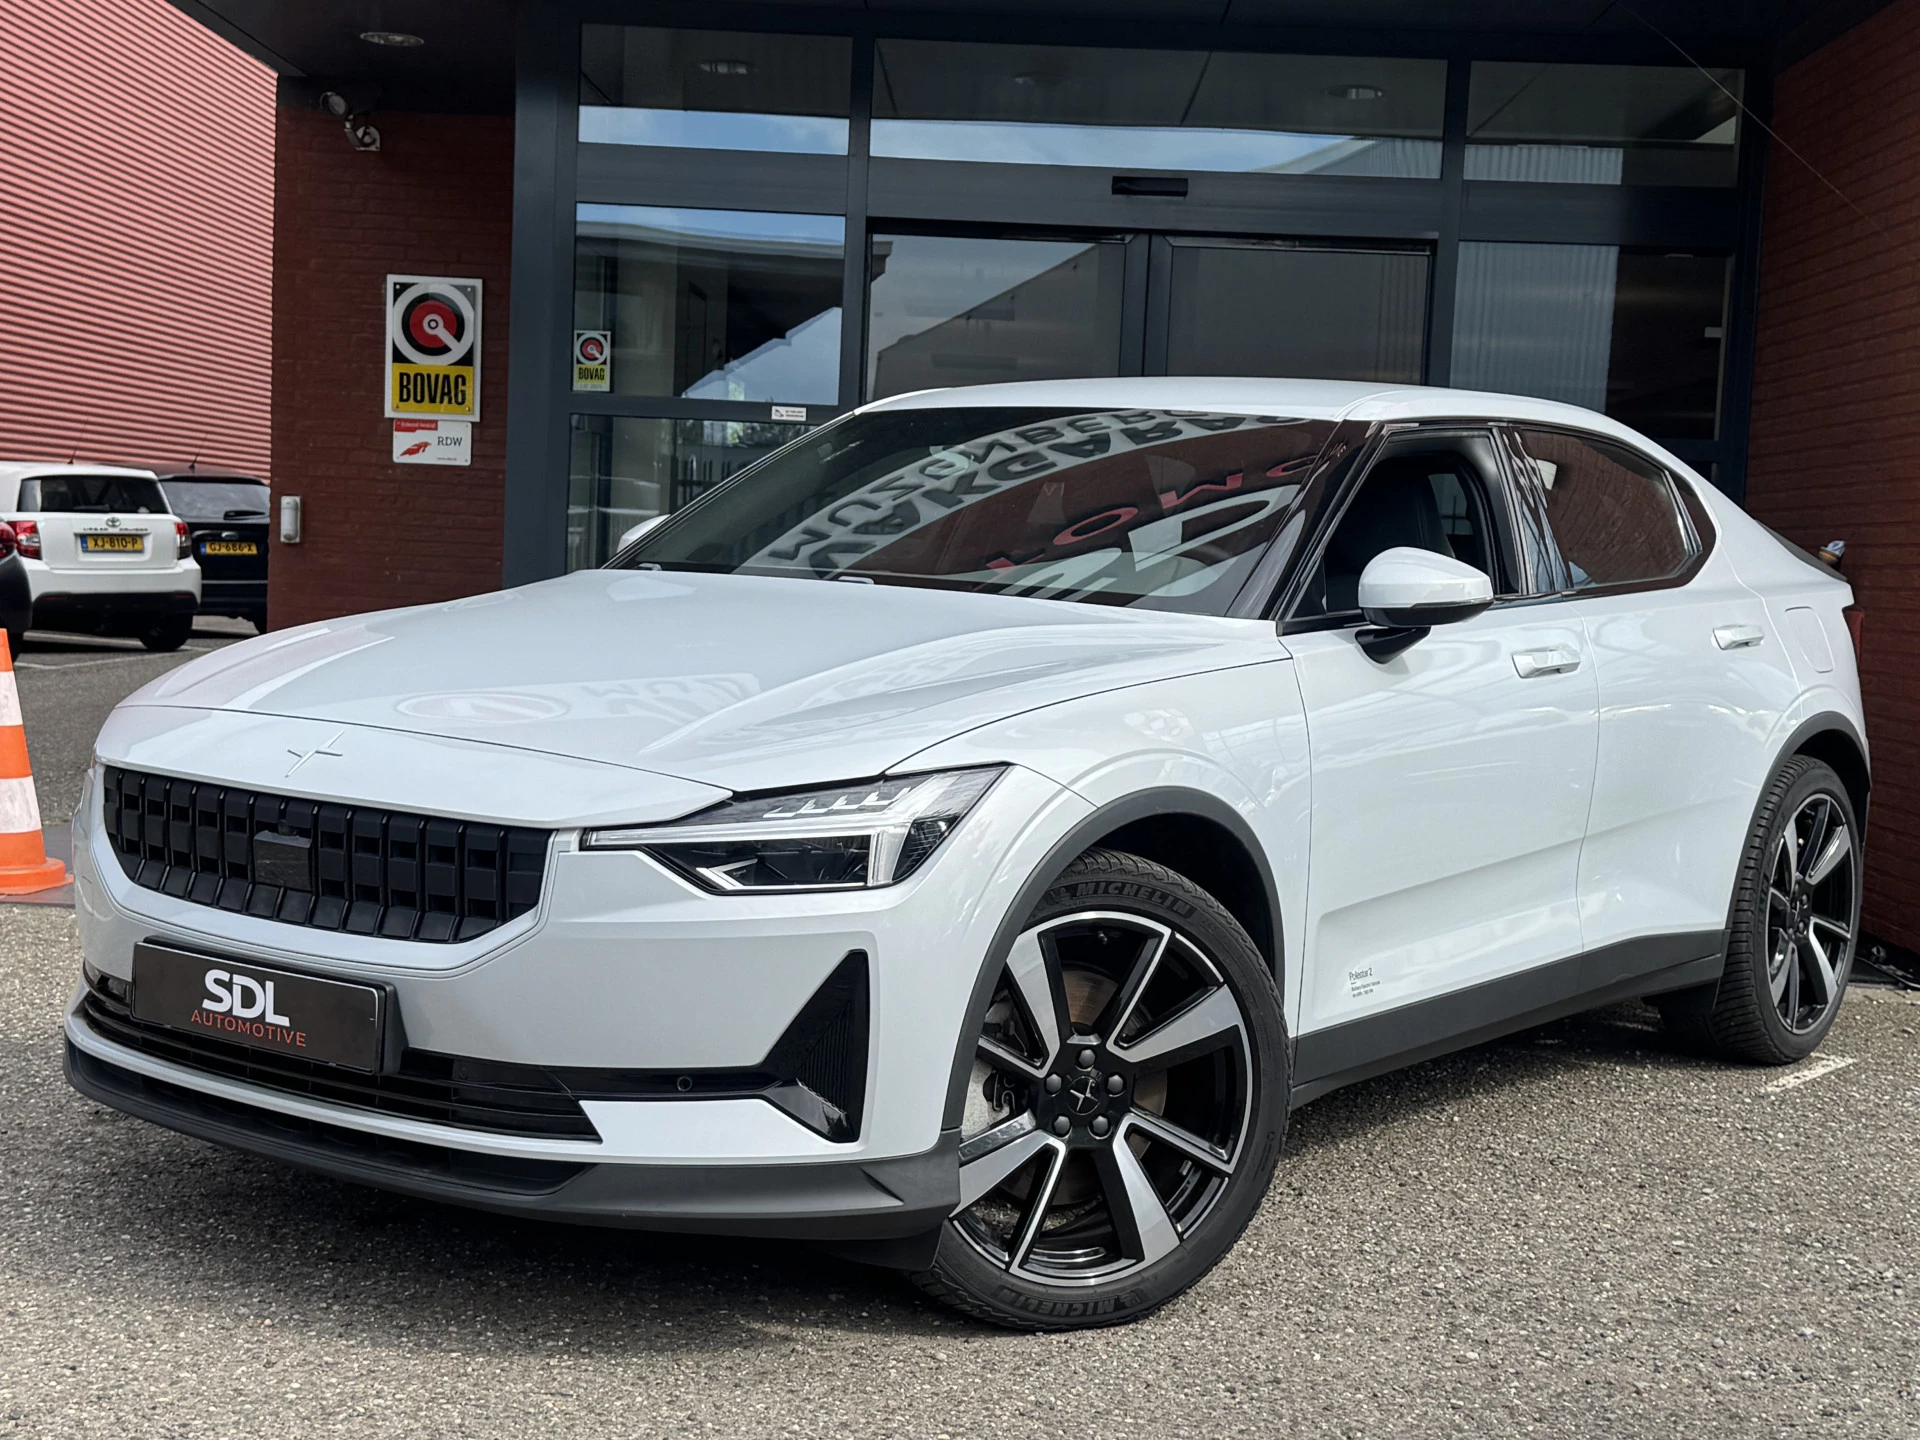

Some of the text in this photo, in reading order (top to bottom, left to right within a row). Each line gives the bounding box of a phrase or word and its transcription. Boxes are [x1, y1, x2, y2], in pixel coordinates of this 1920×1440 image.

[578, 367, 605, 381] BOVAG
[399, 372, 467, 406] BOVAG
[437, 435, 463, 447] RDW
[93, 536, 138, 549] XJ-810-P
[1076, 882, 1193, 916] MICHELIN
[1349, 969, 1369, 981] Polestar
[202, 968, 291, 1028] SDL
[191, 1008, 307, 1048] AUTOMOTIVE
